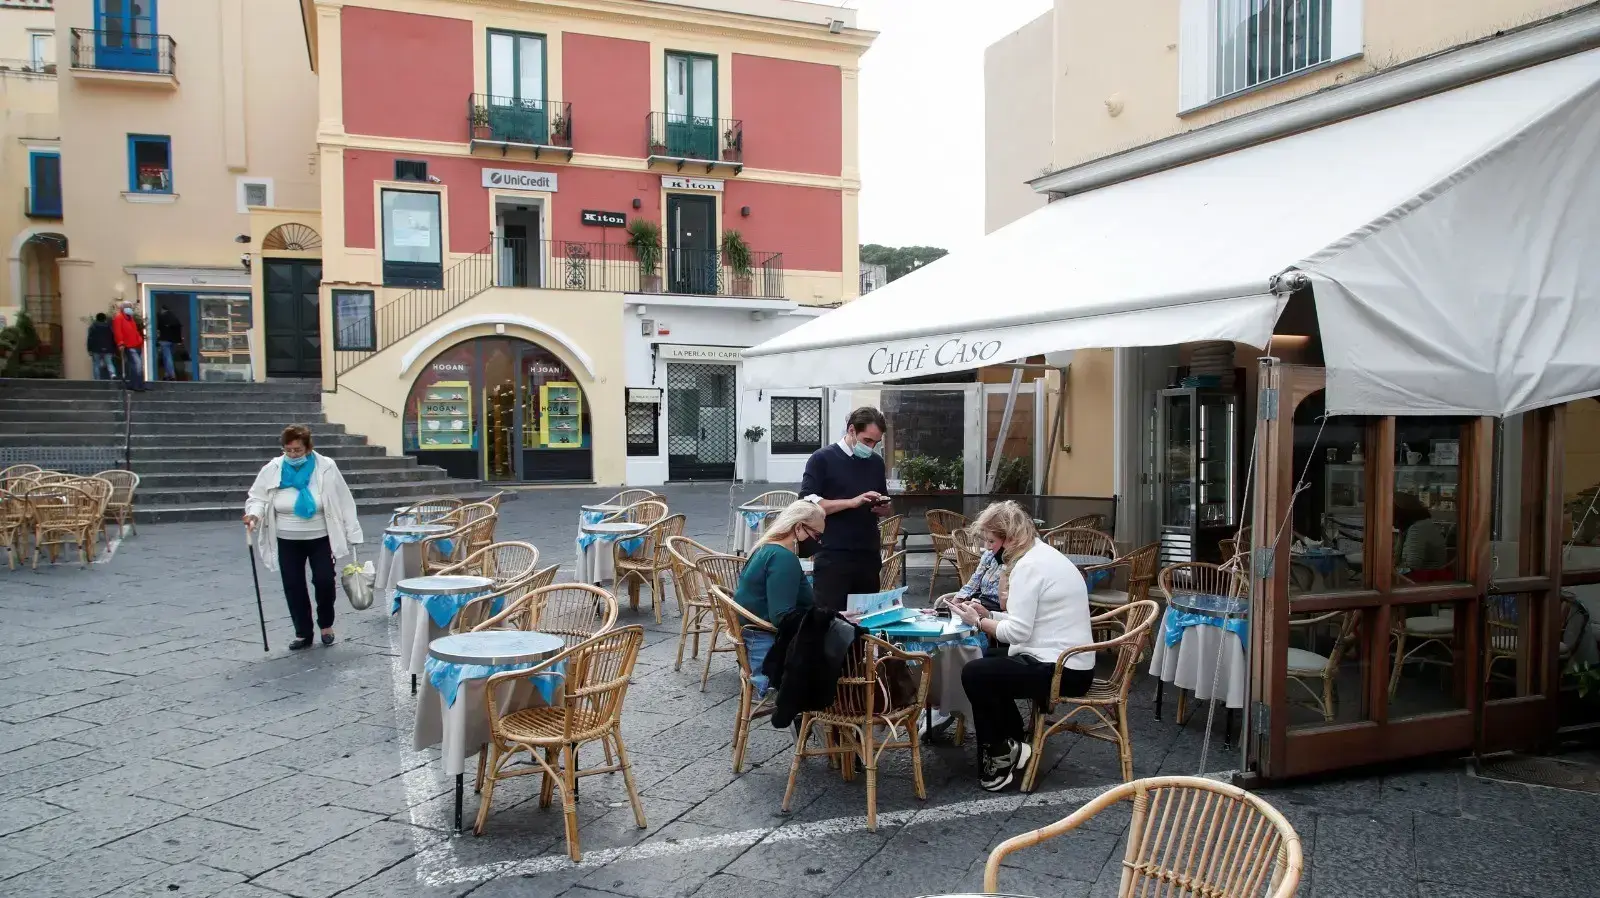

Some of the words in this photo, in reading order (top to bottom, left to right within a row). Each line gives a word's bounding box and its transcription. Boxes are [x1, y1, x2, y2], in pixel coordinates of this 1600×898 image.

[504, 174, 550, 187] UniCredit
[672, 178, 716, 190] Kiton
[584, 212, 624, 224] Kiton
[867, 344, 929, 376] CAFFÈ
[934, 336, 1002, 366] CASO
[432, 363, 464, 371] HOGAN
